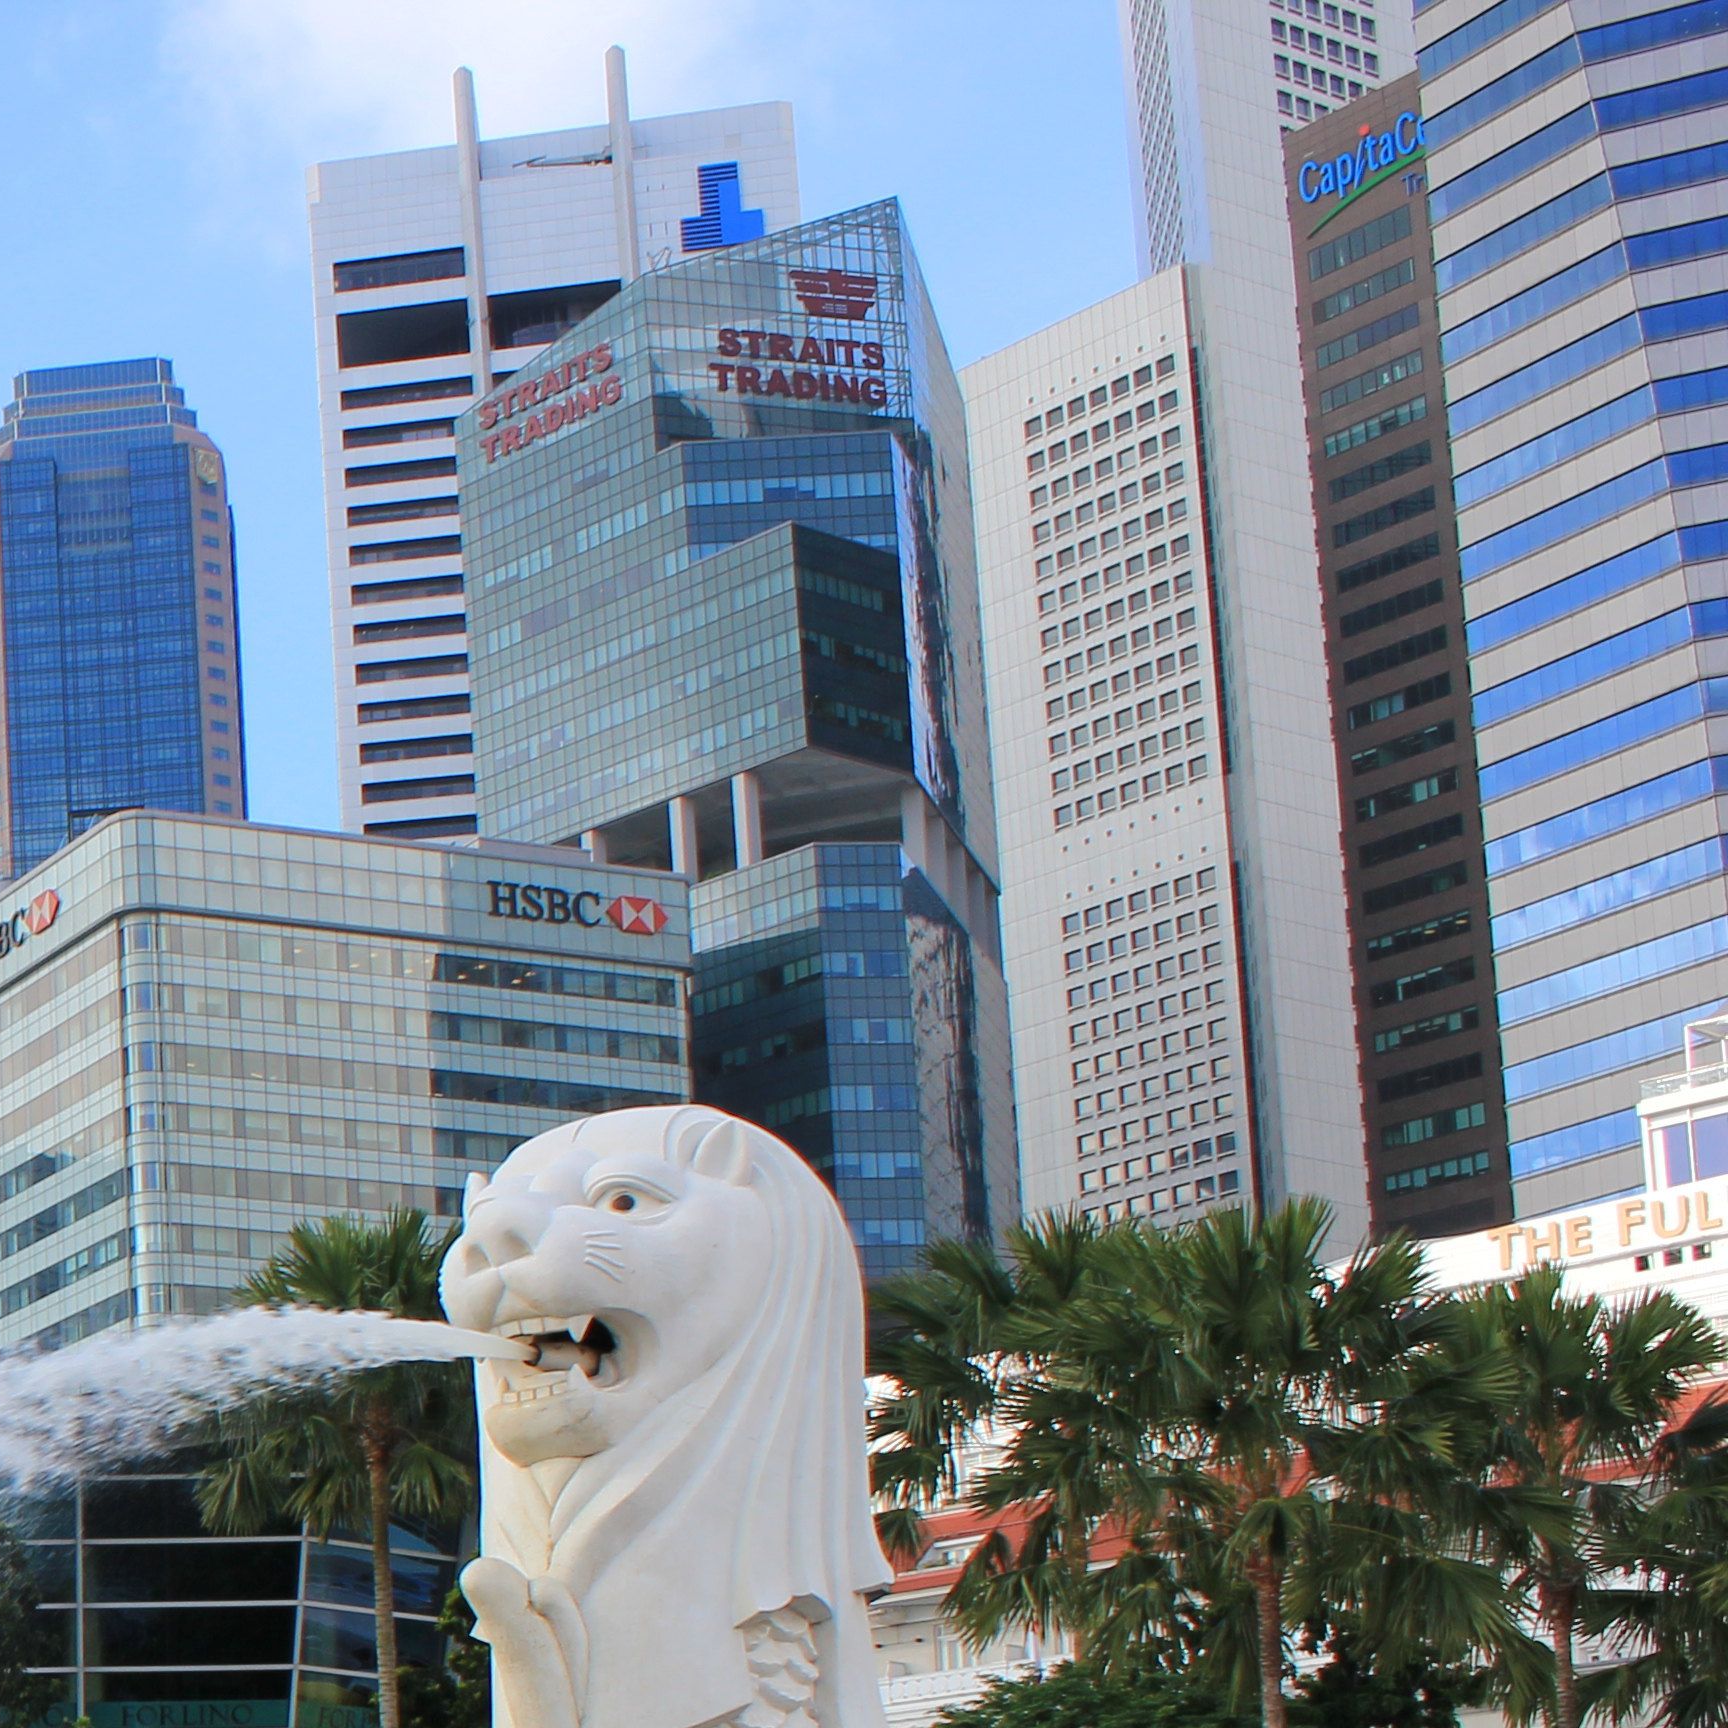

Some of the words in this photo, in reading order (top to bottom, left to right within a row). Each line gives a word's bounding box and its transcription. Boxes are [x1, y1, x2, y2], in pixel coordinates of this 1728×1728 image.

[718, 328, 885, 370] STRAITS
[478, 342, 614, 430] STRAITS
[709, 362, 887, 407] TRADING
[480, 374, 622, 464] TRADING
[487, 880, 601, 928] HSBC
[1487, 1215, 1594, 1271] THE
[121, 1704, 253, 1727] FORLINO
